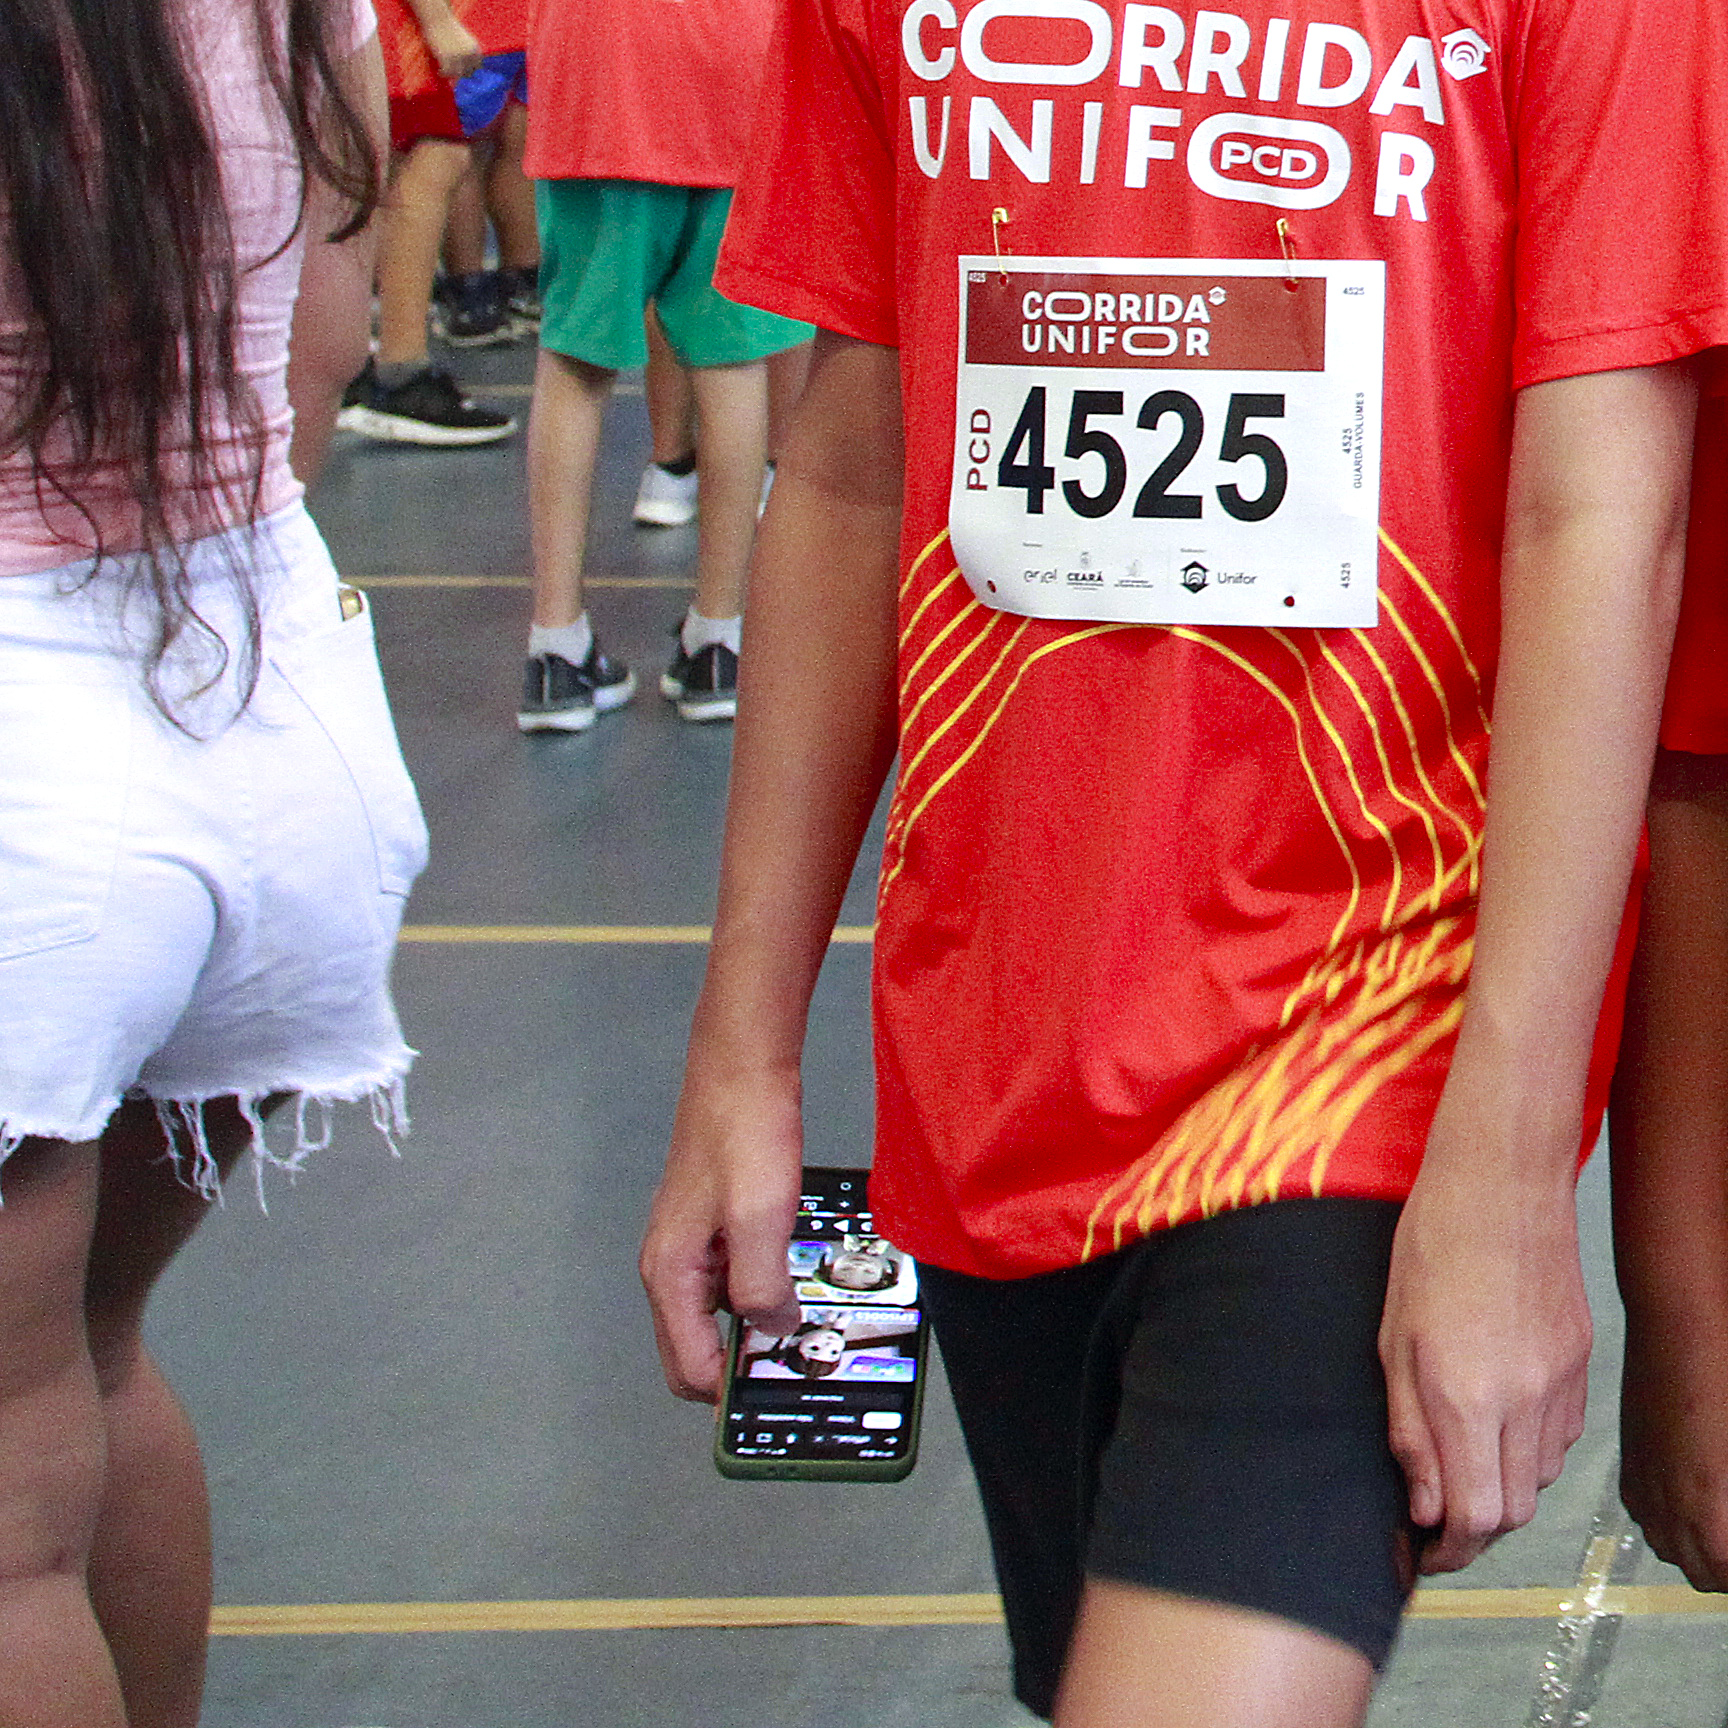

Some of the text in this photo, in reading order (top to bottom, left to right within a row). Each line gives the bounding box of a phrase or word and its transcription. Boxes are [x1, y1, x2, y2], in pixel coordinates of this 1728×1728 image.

[907, 94, 1436, 223] UNIFOR
[1219, 139, 1318, 180] PCD
[1021, 290, 1211, 325] CORRIDA
[1021, 325, 1211, 358] UNIFOR
[966, 407, 992, 492] PCD
[996, 384, 1289, 523] 4525
[1341, 427, 1353, 455] 4525
[1217, 571, 1258, 586] Unifor
[1340, 561, 1352, 590] 4525
